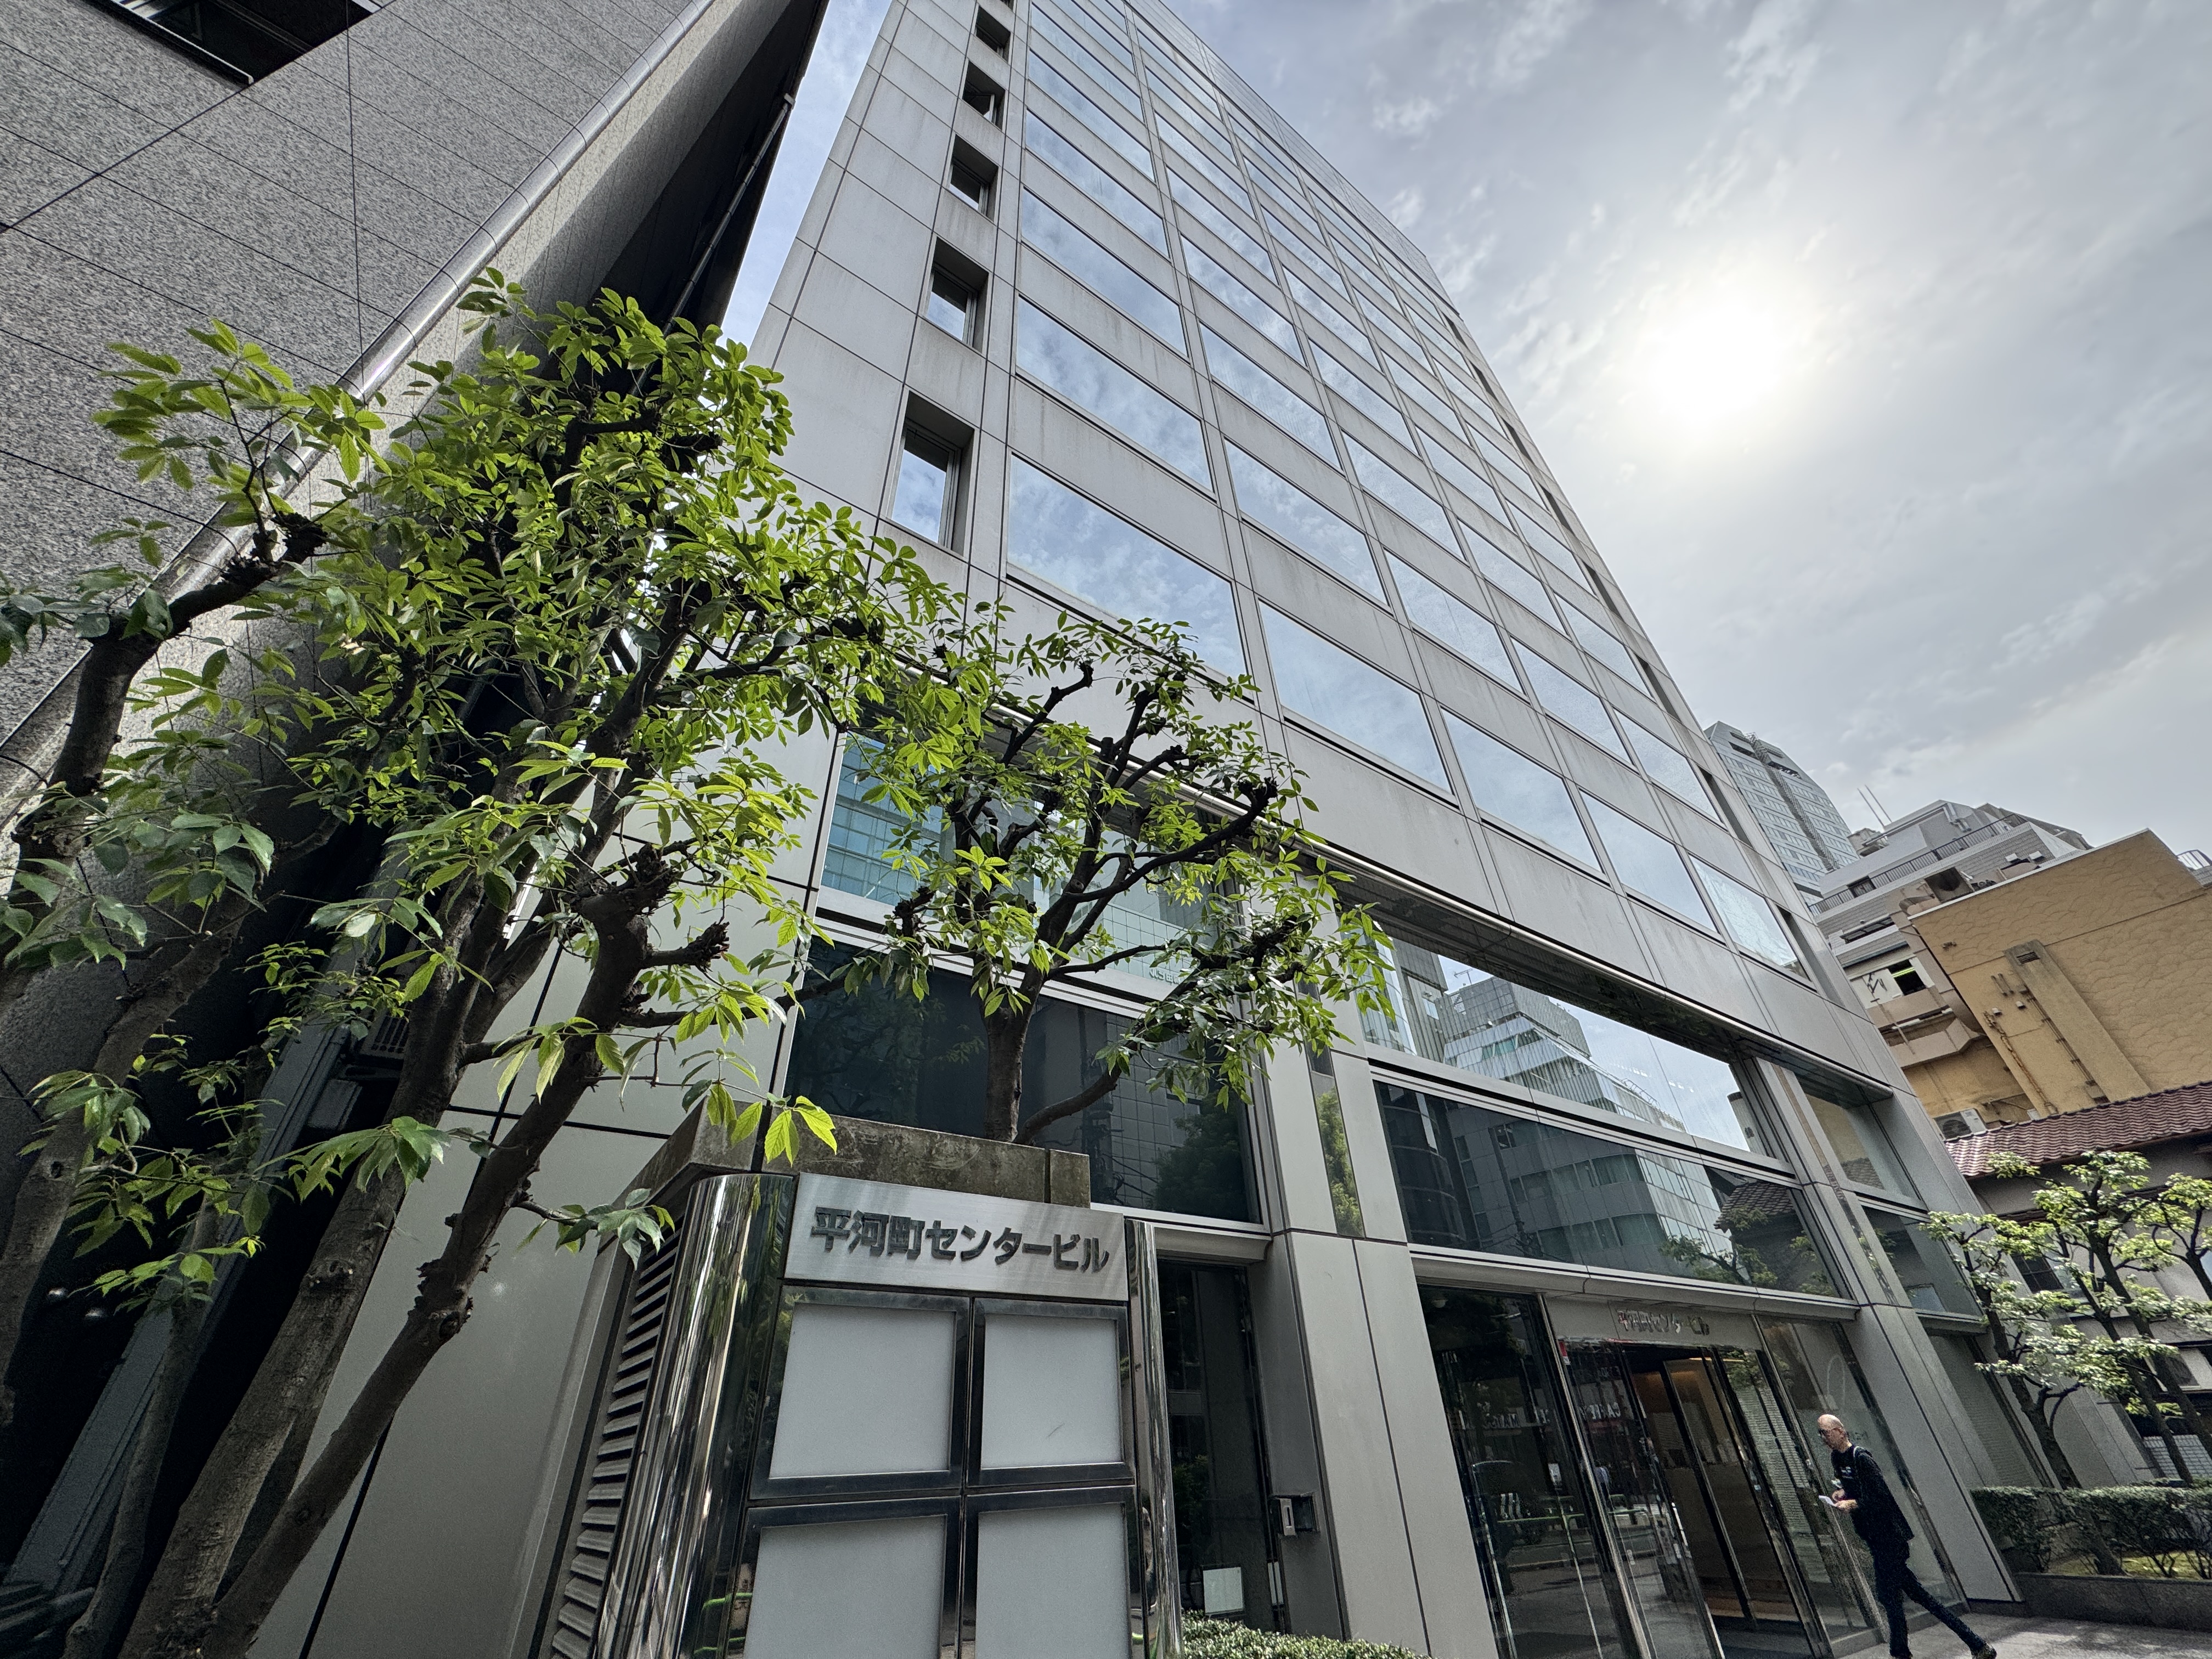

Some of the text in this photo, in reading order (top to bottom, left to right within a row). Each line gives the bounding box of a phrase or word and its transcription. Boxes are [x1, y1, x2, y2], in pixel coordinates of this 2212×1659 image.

[810, 1206, 1110, 1273] 平河町センタービル
